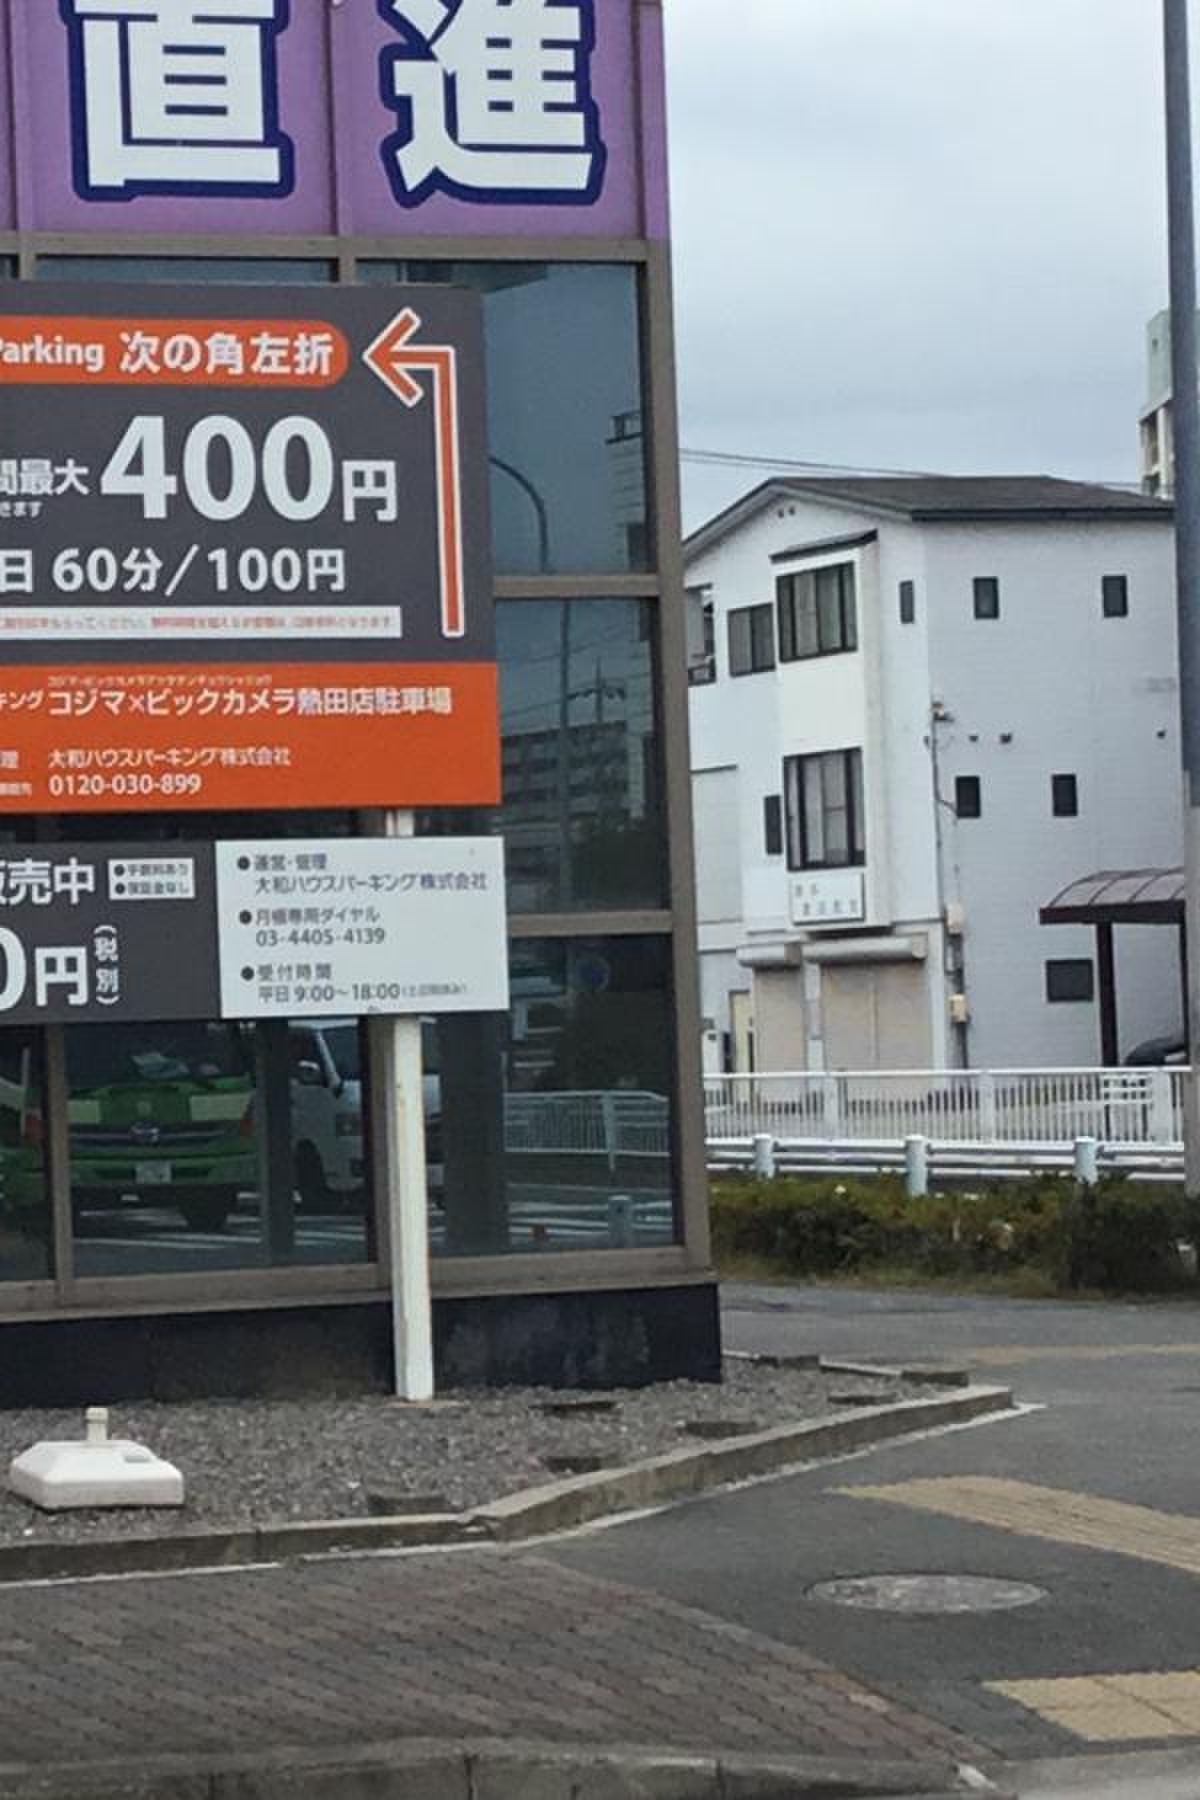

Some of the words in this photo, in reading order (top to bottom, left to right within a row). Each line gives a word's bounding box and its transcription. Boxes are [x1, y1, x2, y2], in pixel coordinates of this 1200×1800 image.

[119, 332, 334, 375] 次の角左折
[100, 414, 399, 522] 400円
[50, 774, 202, 795] 0120-030-899
[256, 928, 385, 946] 03-4405-4139
[257, 964, 332, 981] 受付時間
